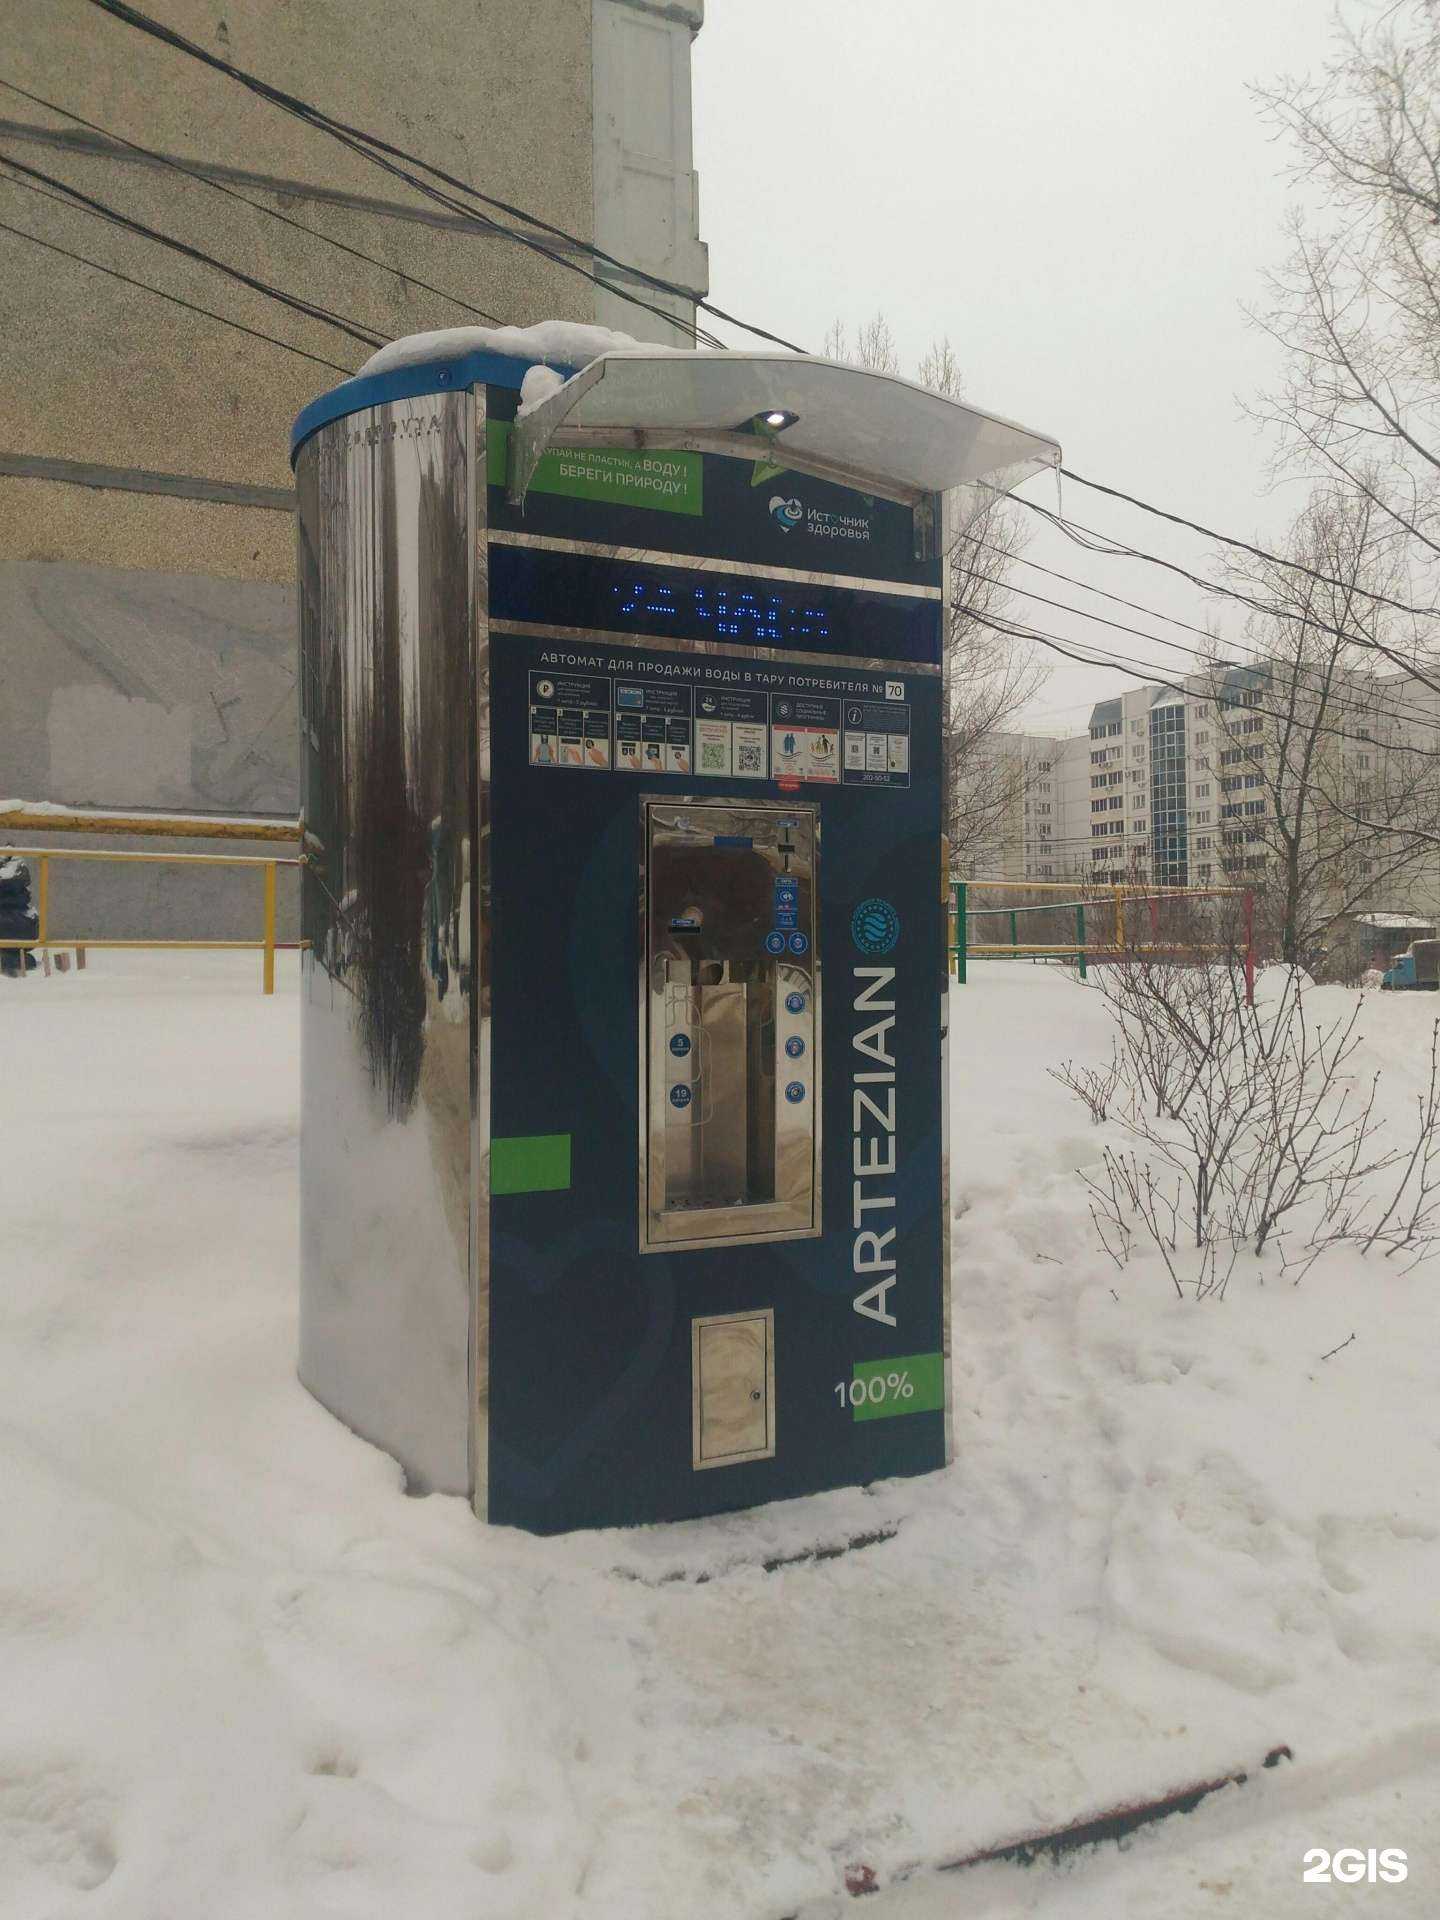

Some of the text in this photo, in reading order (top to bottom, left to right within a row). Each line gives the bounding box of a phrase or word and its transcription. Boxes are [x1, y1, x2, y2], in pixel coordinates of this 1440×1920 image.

[574, 451, 586, 462] НЕ
[560, 463, 613, 483] БЕРЕГИ
[807, 508, 869, 529] Истчник
[540, 652, 604, 668] АВТОМАТ
[608, 658, 633, 671] ДЛЯ
[638, 661, 701, 678] ПРОДАЖИ
[705, 667, 740, 681] ВОДЫ
[744, 672, 752, 681] В
[755, 673, 784, 686] ТАРУ
[788, 676, 869, 693] ПОТРЕБИТЕЛЯ
[888, 685, 902, 697] 70
[852, 967, 897, 1329] ARTEZIAN
[834, 1371, 915, 1408] 100%
